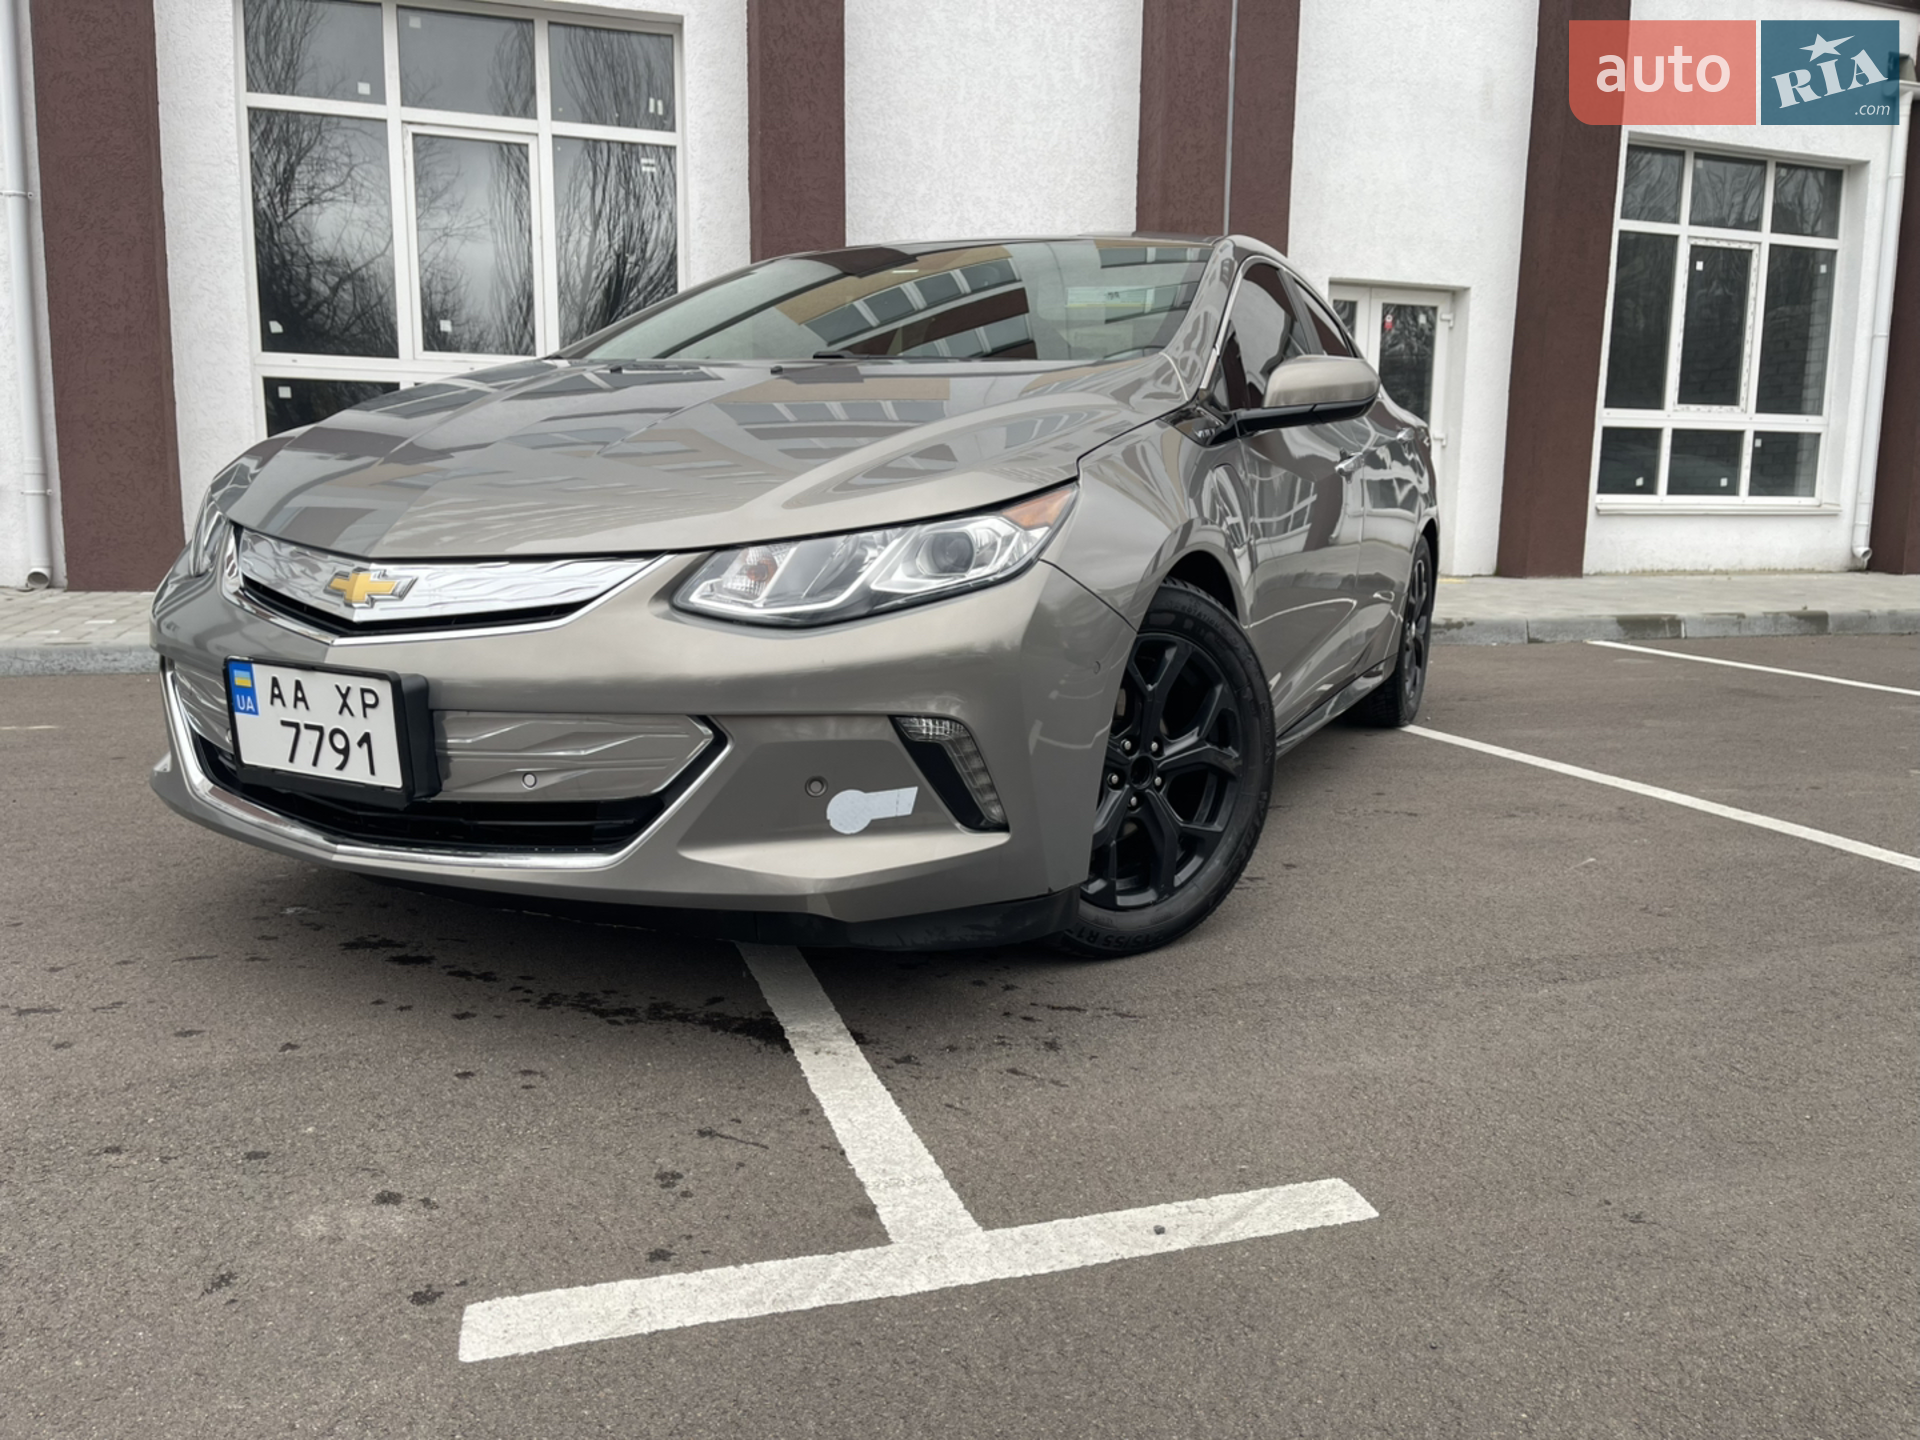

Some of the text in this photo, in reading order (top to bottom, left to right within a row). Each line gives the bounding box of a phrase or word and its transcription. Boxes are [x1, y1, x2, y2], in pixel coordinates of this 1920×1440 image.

[236, 694, 256, 712] UA
[269, 676, 380, 718] AA XP
[280, 719, 376, 776] 7791
